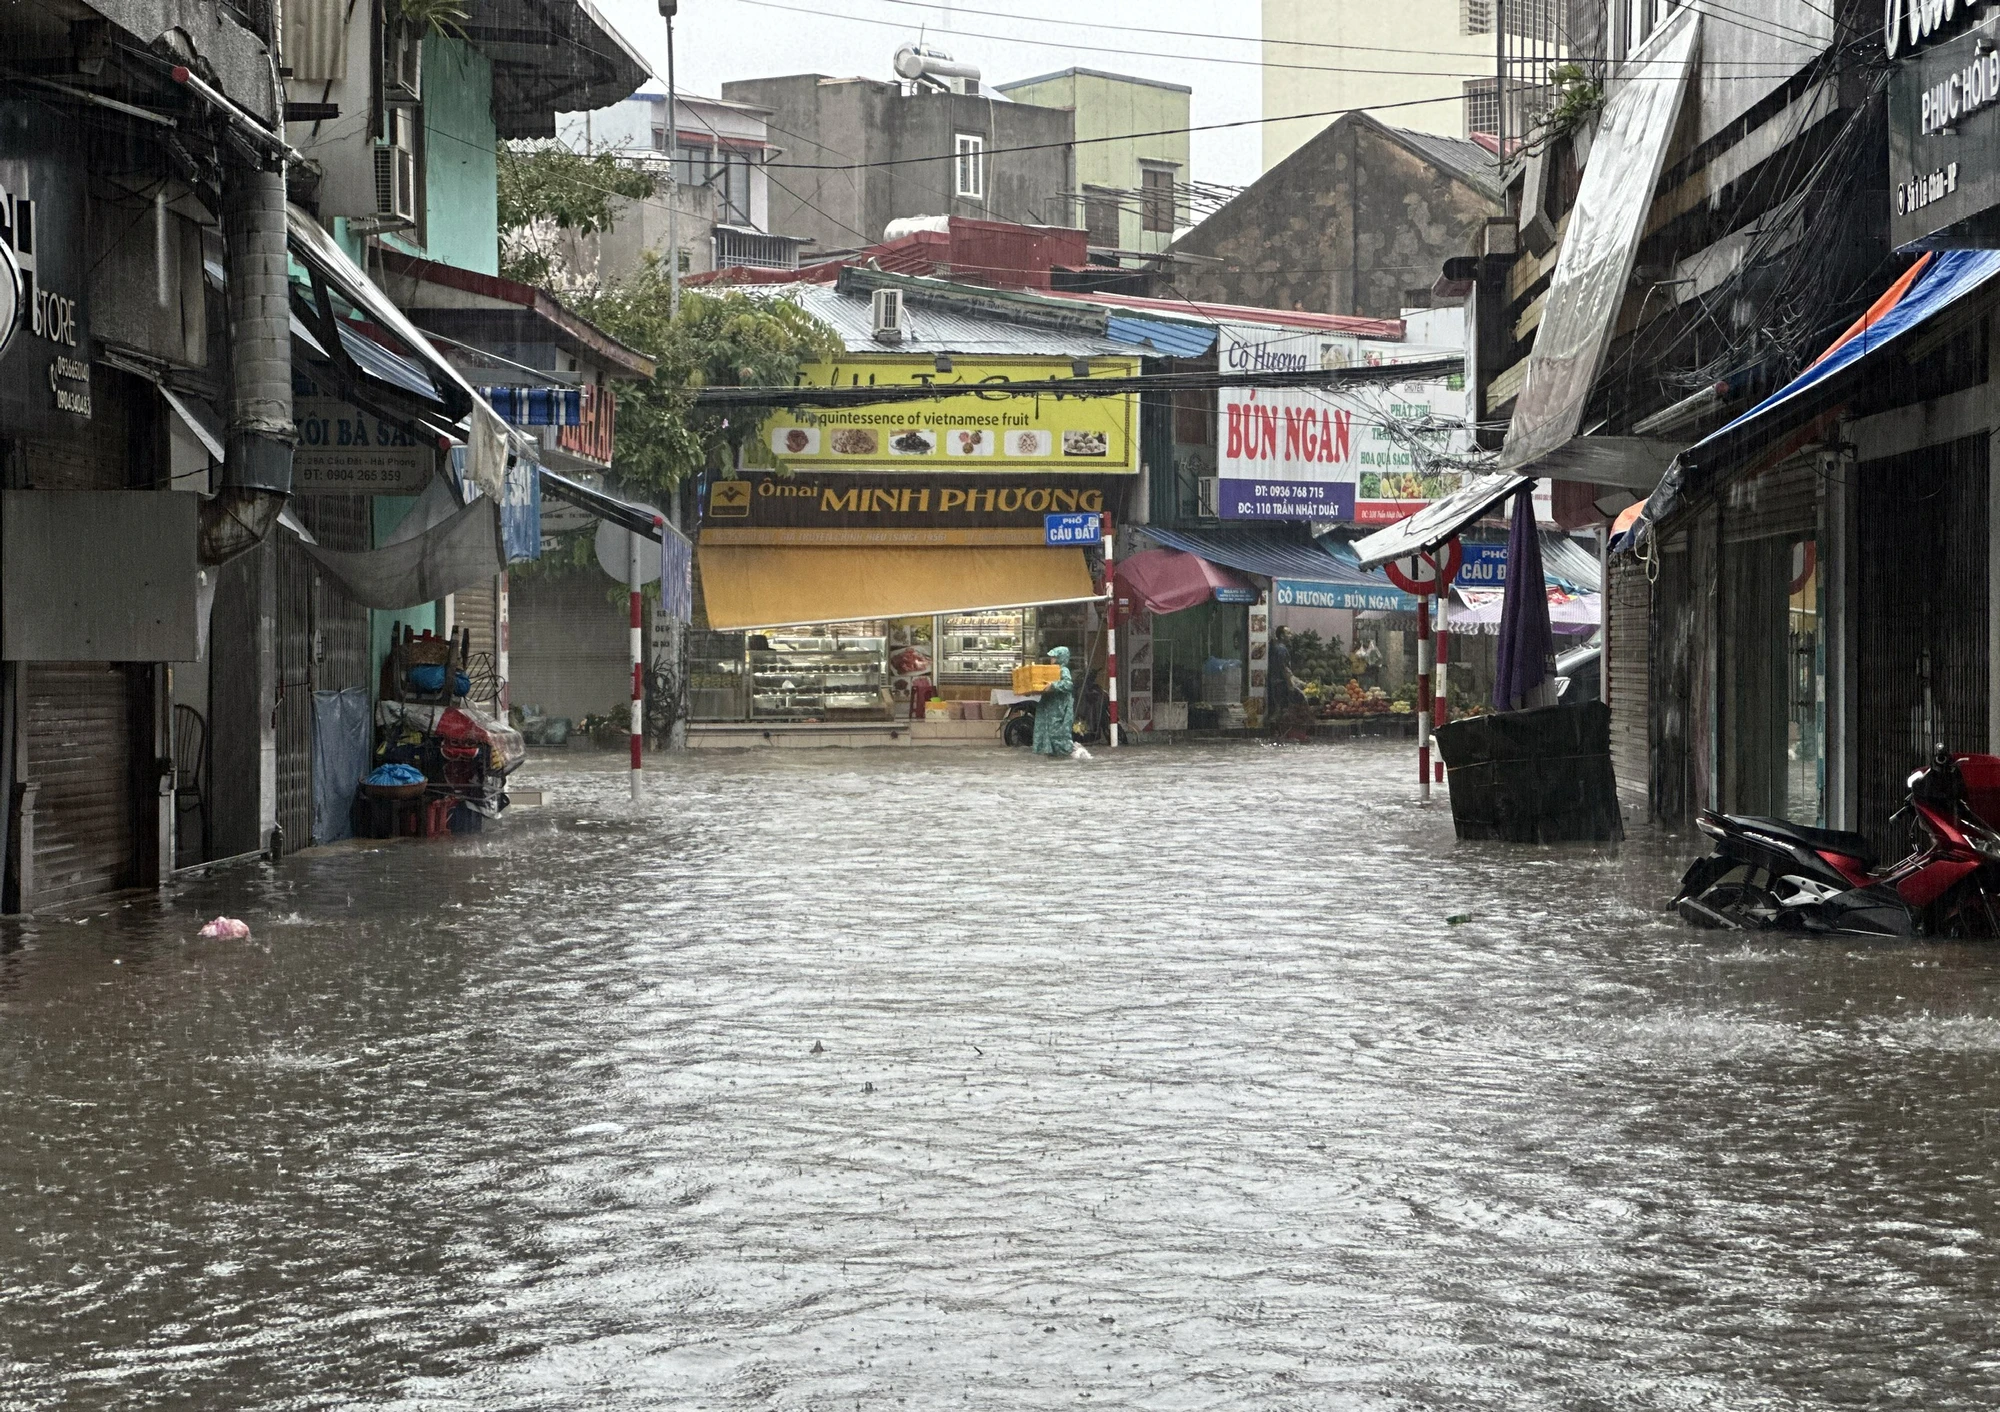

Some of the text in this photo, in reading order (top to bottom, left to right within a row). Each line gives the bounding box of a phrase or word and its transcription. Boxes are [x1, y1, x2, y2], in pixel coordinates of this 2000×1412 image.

[1921, 72, 1960, 136] PHỤC
[1228, 340, 1308, 372] Cô Hương
[820, 412, 905, 427] quintessence
[907, 411, 922, 425] of
[923, 411, 999, 426] vietnamese
[1002, 412, 1030, 426] fruit
[1226, 388, 1351, 464] BÚN NGAN
[1360, 451, 1376, 465] HOA
[326, 468, 354, 481] 0904
[356, 468, 378, 481] 265
[381, 468, 401, 481] 359
[757, 477, 820, 497] Ômai
[1255, 485, 1325, 499] ĐT: 0936 768 715
[819, 487, 1104, 513] MINH PHƯƠNG
[1237, 498, 1340, 519] ĐC: 110 TRẦN NHẬT DUẬT
[1062, 514, 1083, 525] PHỐ
[1050, 526, 1075, 541] CẦU
[1074, 524, 1096, 539] ĐẤT
[1461, 558, 1493, 580] CẦU
[1277, 585, 1293, 605] CÔ
[1295, 589, 1335, 607] HƯƠNG
[1343, 589, 1367, 609] BÚN
[1368, 595, 1399, 611] NGAN
